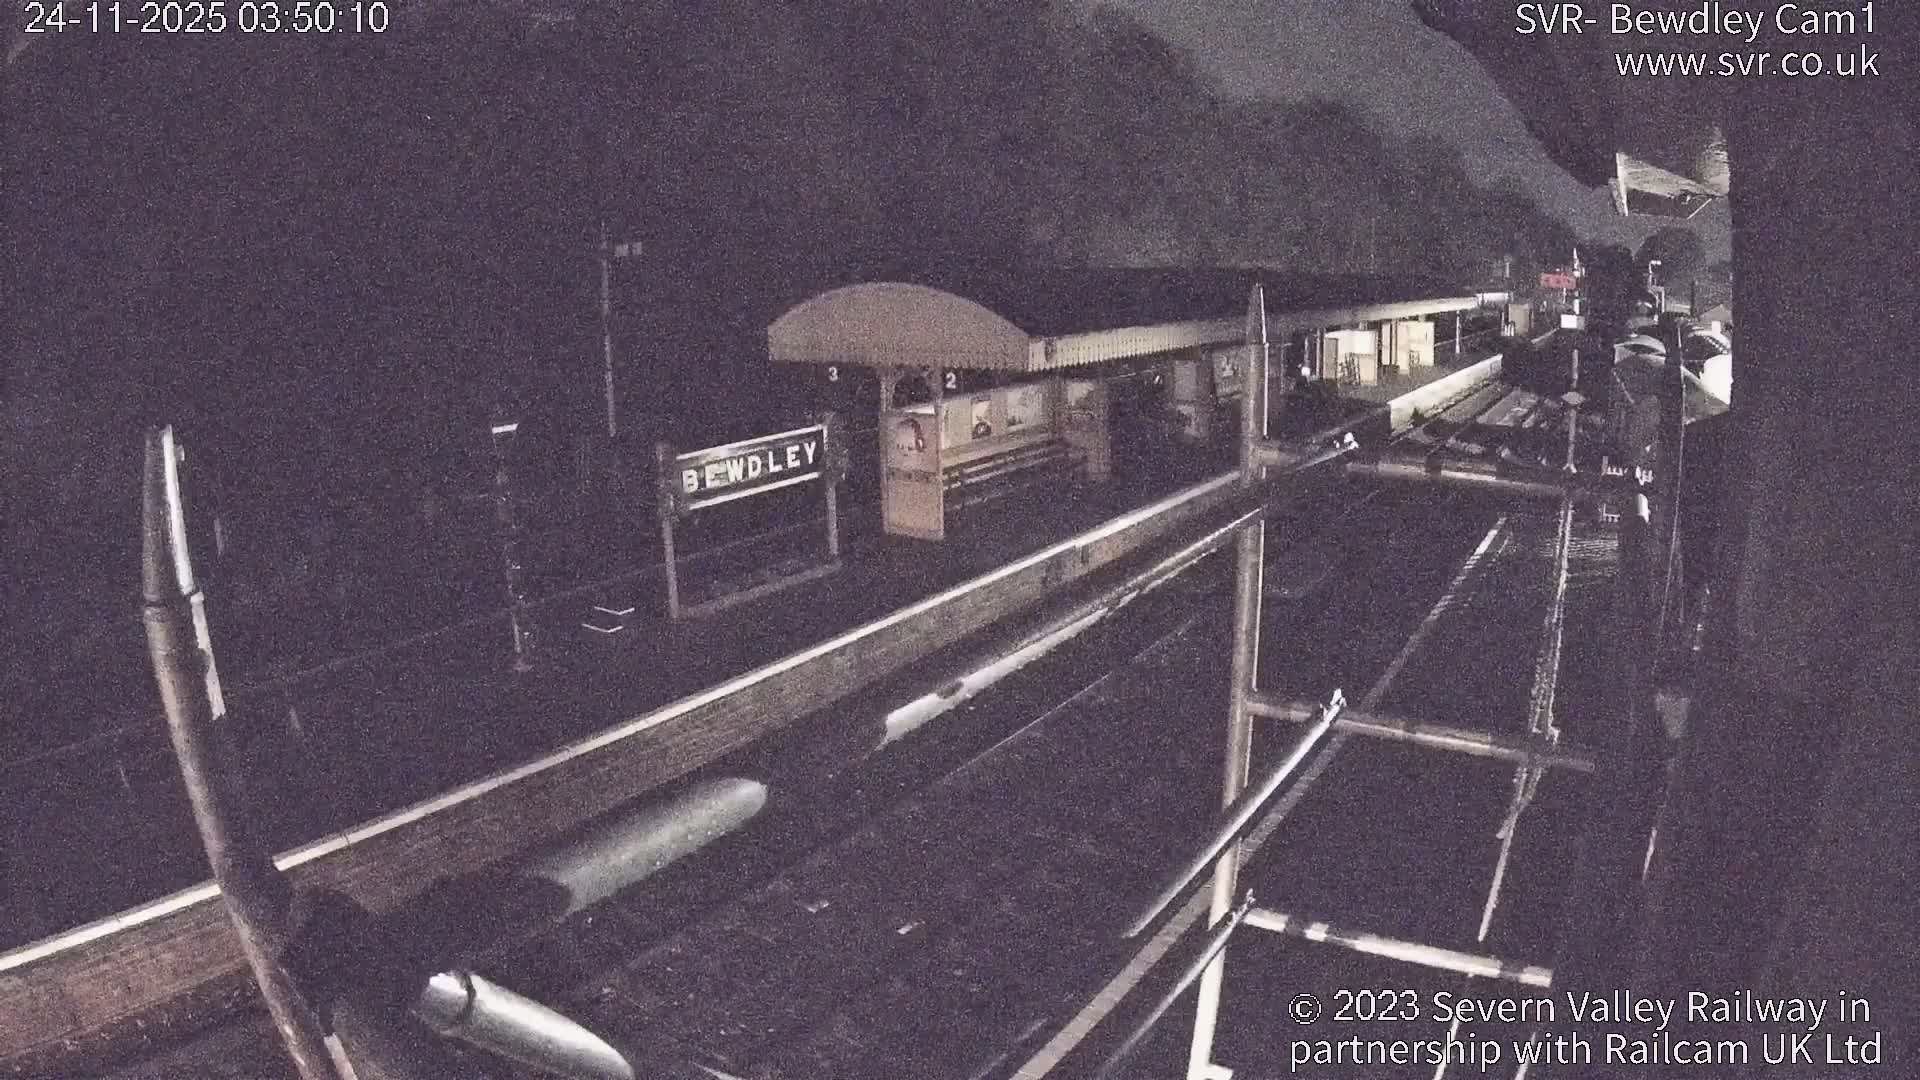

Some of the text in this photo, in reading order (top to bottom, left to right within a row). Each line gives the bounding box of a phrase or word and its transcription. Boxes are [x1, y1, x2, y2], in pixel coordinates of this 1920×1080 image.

[828, 366, 839, 383] 3
[945, 372, 956, 388] 2
[681, 440, 817, 493] BEWDLEY
